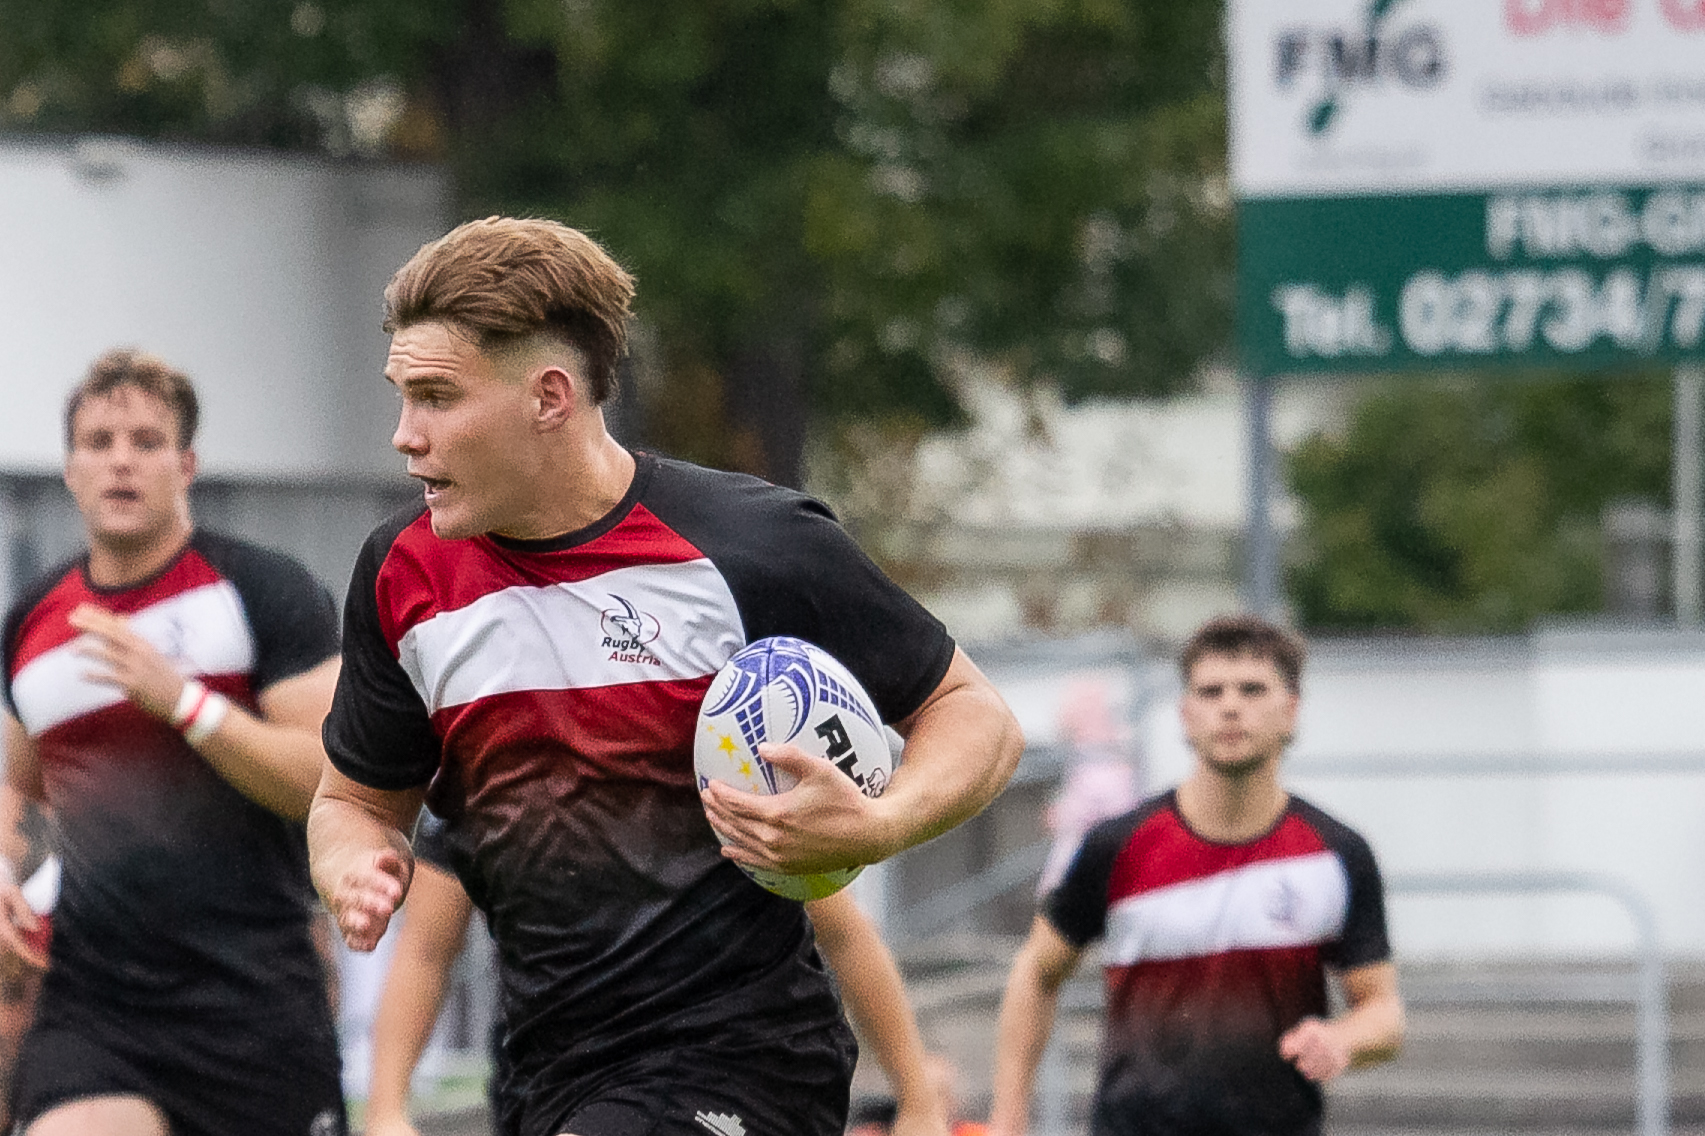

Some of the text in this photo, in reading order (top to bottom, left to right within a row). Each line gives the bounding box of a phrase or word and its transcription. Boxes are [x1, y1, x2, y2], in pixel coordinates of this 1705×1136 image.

[1272, 22, 1448, 90] FMG
[1486, 194, 1705, 260] FMG-G
[1272, 280, 1394, 358] Tel.
[601, 636, 646, 656] Rugby
[608, 651, 661, 666] Austria
